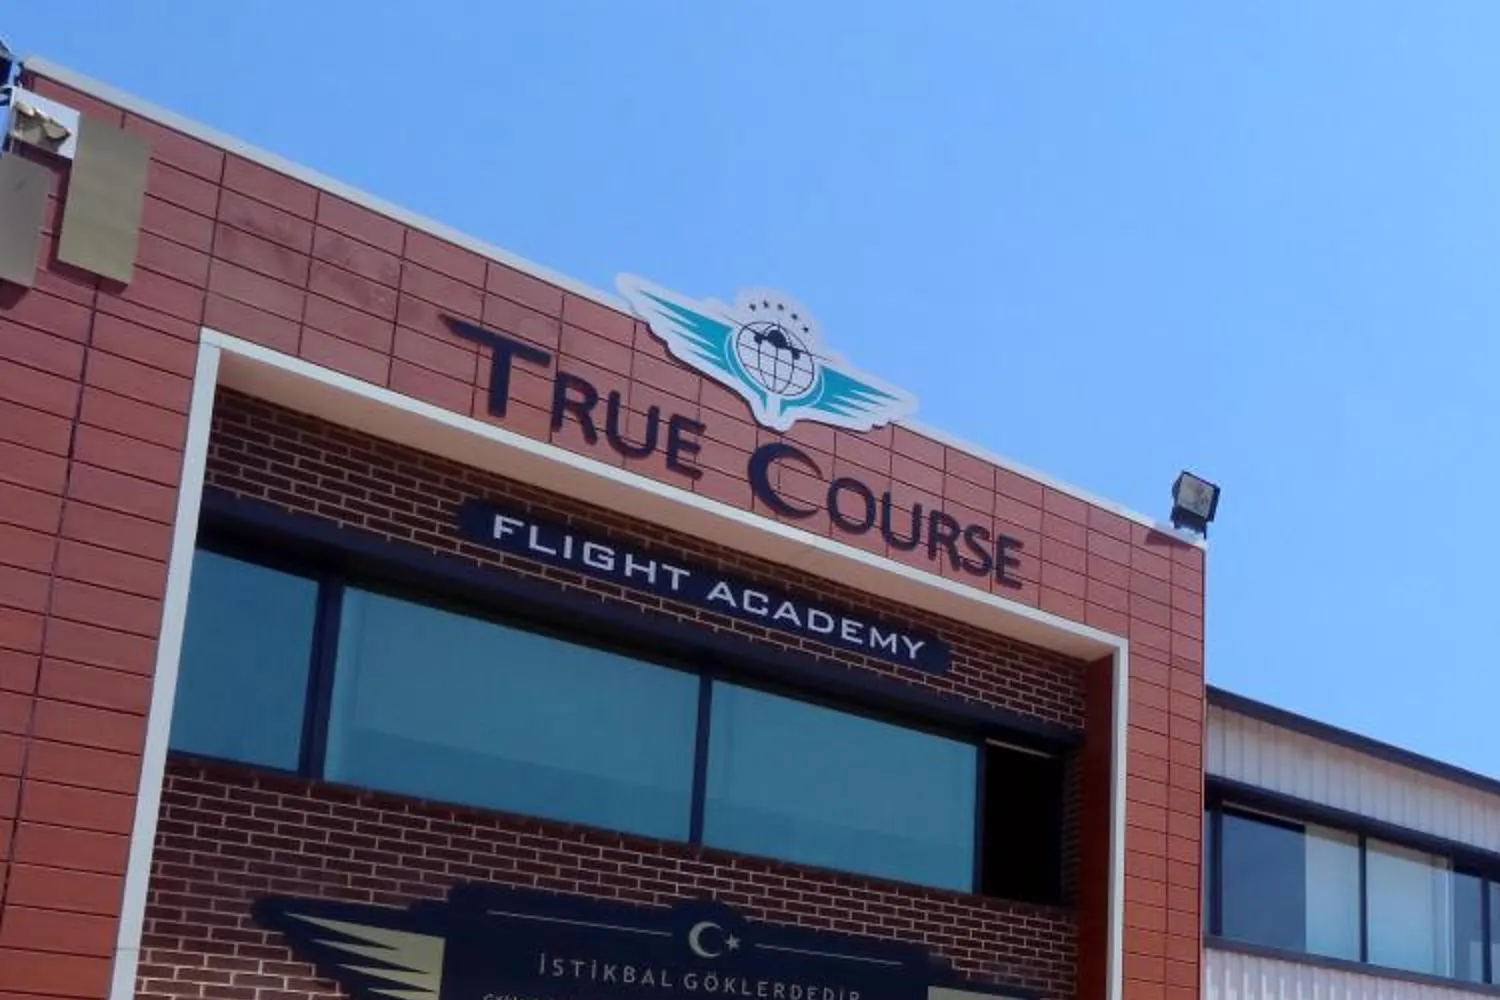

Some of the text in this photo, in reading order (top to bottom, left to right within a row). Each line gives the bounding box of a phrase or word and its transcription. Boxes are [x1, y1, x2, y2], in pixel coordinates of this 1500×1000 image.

[440, 312, 1026, 591] TRUE COURSE
[493, 513, 926, 661] FLIGHT ACADEMY
